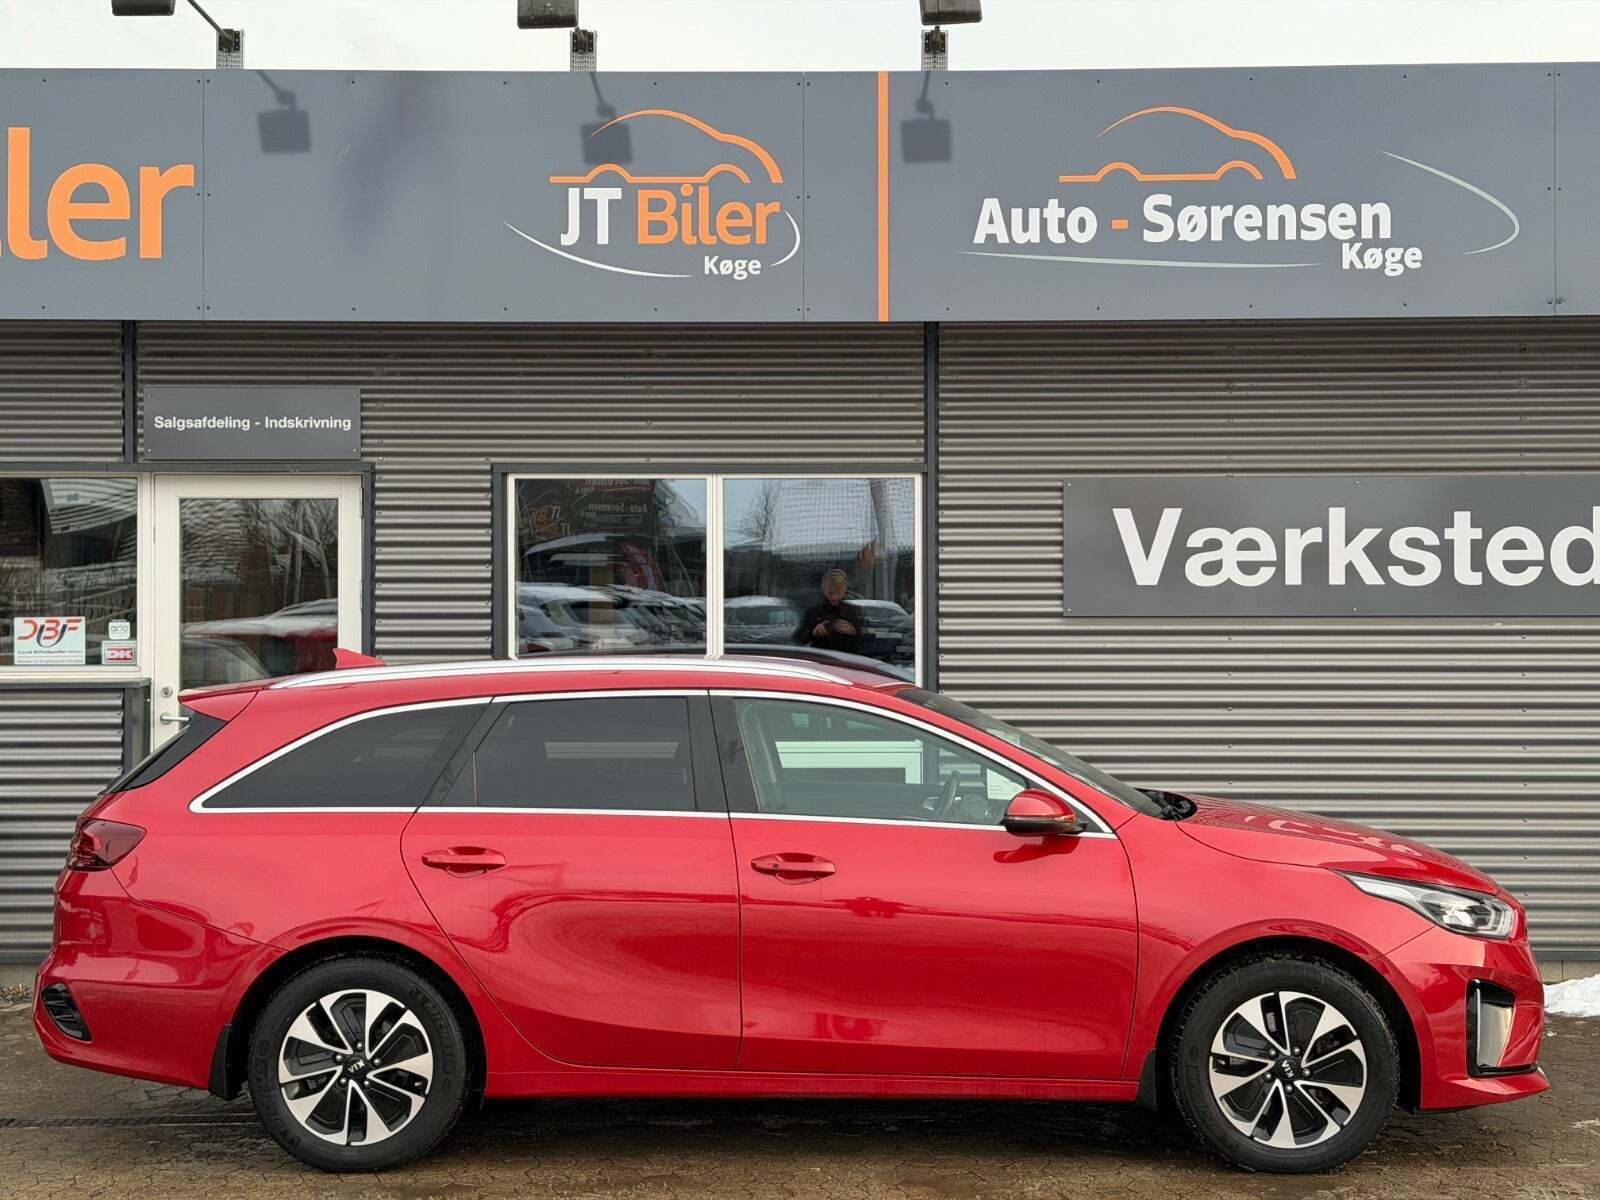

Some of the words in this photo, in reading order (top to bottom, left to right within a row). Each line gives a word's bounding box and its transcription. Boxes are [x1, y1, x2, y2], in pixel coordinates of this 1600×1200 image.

[0, 127, 195, 260] ler
[560, 187, 622, 246] JT
[637, 183, 780, 245] Biler
[973, 198, 1098, 245] Auto
[1142, 194, 1392, 243] Sørensen
[704, 255, 762, 280] Køge
[1341, 242, 1423, 277] Køge
[154, 416, 251, 431] Salgsafdeling
[265, 416, 351, 431] Indskrivning
[1112, 505, 1600, 588] Værksted
